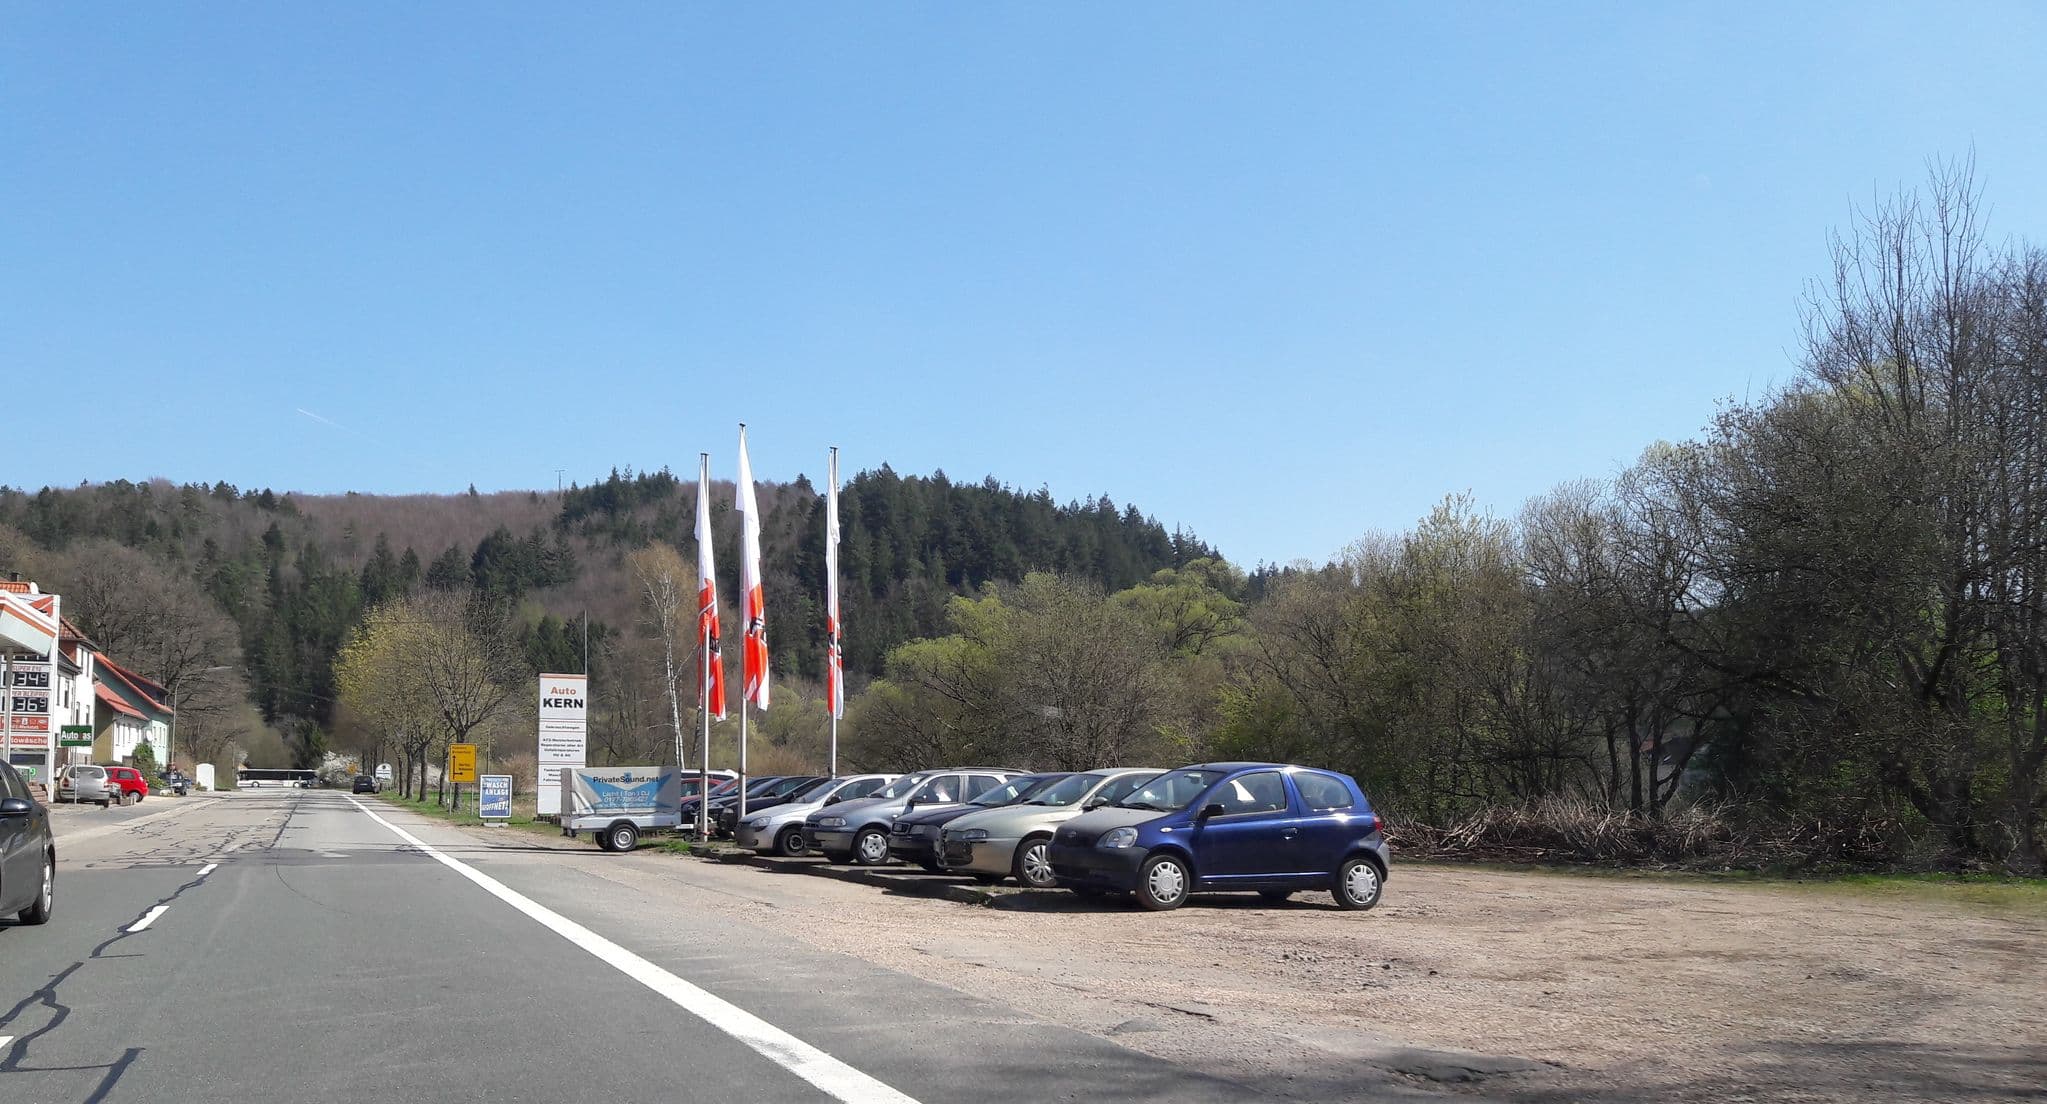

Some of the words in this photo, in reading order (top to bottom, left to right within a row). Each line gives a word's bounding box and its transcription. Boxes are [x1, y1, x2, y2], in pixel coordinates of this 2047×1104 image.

[551, 686, 577, 695] Auto
[543, 698, 584, 709] KERN
[593, 775, 659, 784] PrivateSound.net
[486, 781, 509, 789] WASCH
